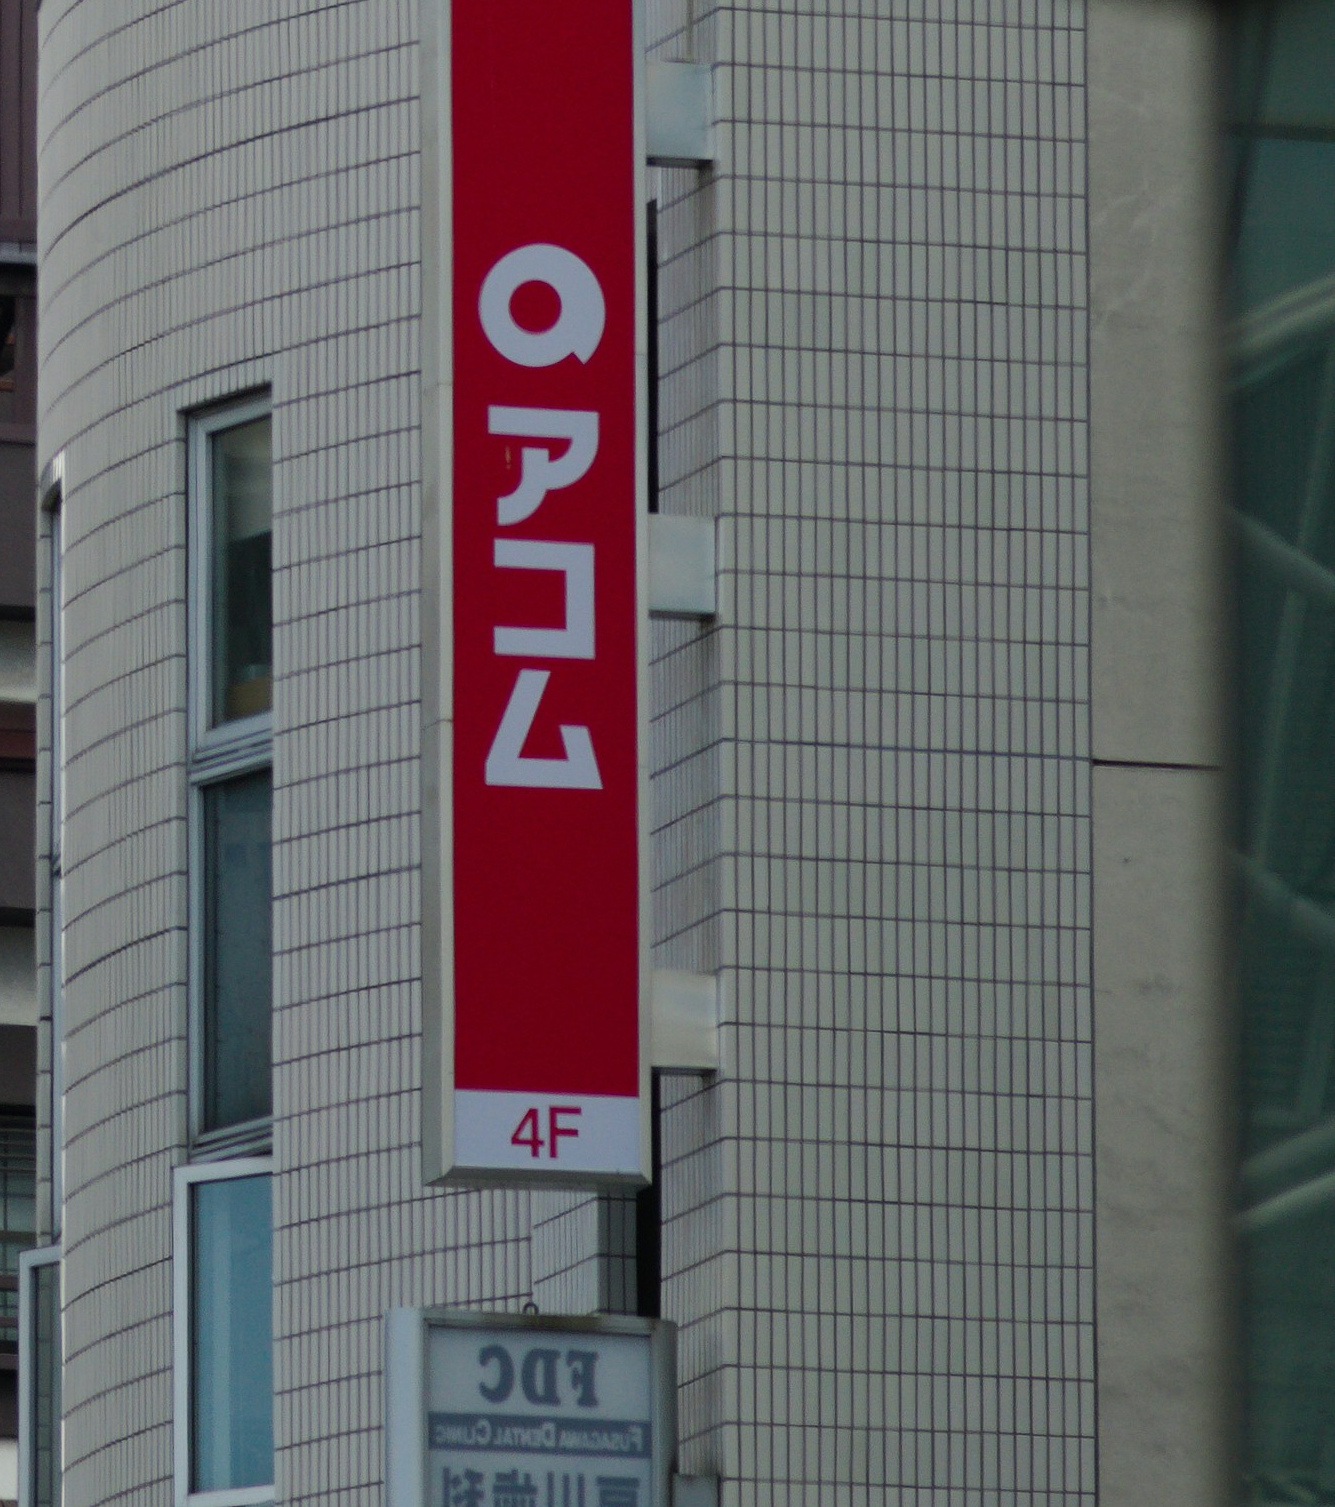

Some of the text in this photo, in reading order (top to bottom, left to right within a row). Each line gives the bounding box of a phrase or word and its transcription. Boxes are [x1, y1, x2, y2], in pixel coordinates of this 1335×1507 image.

[484, 404, 604, 791] アコム
[510, 1104, 583, 1160] 4F
